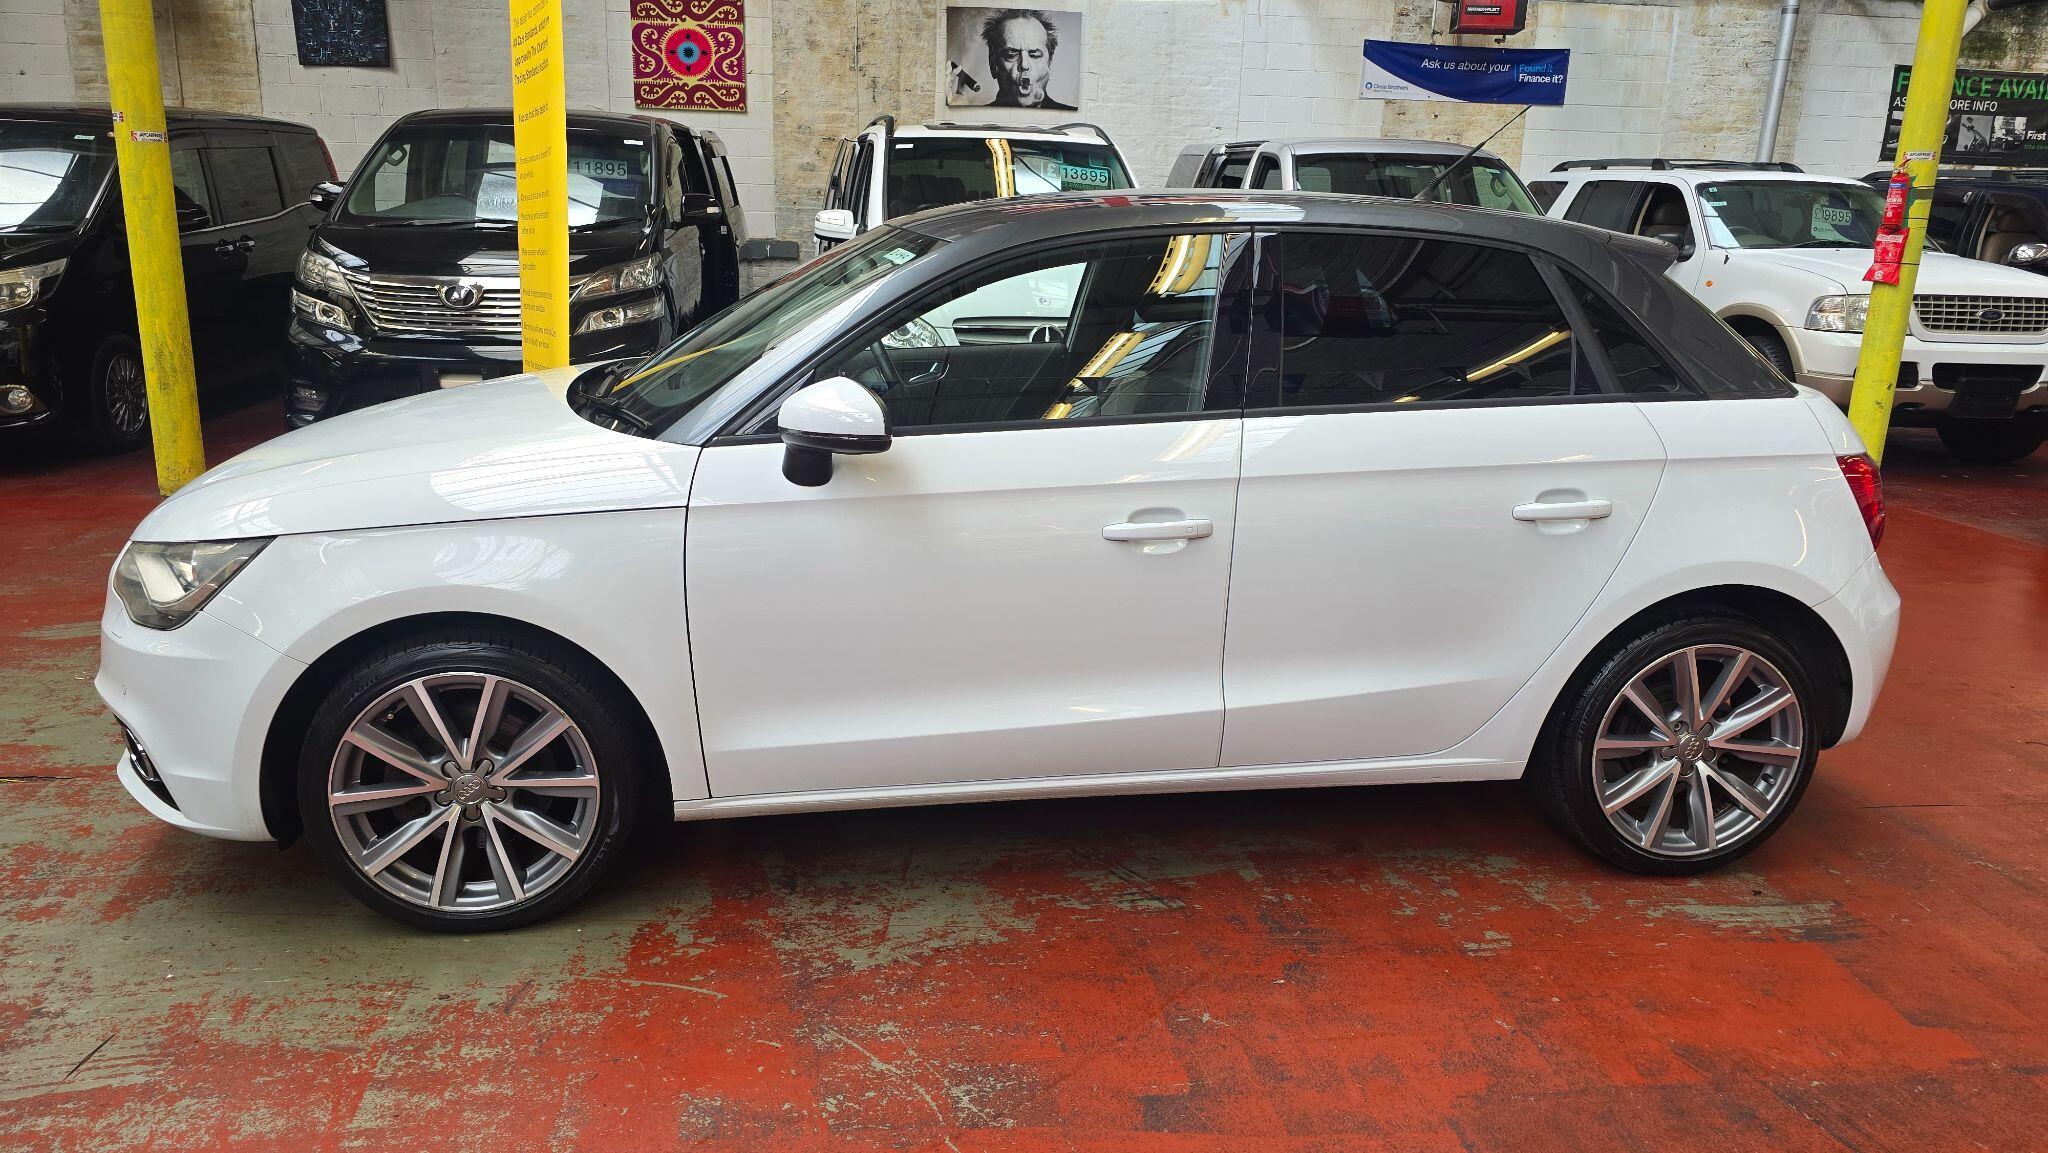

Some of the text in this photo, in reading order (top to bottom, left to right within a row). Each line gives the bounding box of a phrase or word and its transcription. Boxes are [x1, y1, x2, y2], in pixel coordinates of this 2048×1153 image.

[1421, 58, 1511, 74] Ask us about your
[1519, 63, 1554, 73] Found it
[1518, 73, 1564, 84] Finance it?
[1949, 99, 1998, 112] ORE INFO
[2026, 130, 2047, 141] First
[573, 161, 626, 176] 11895
[1062, 168, 1107, 183] 13895
[1814, 207, 1851, 223] £ 9895
